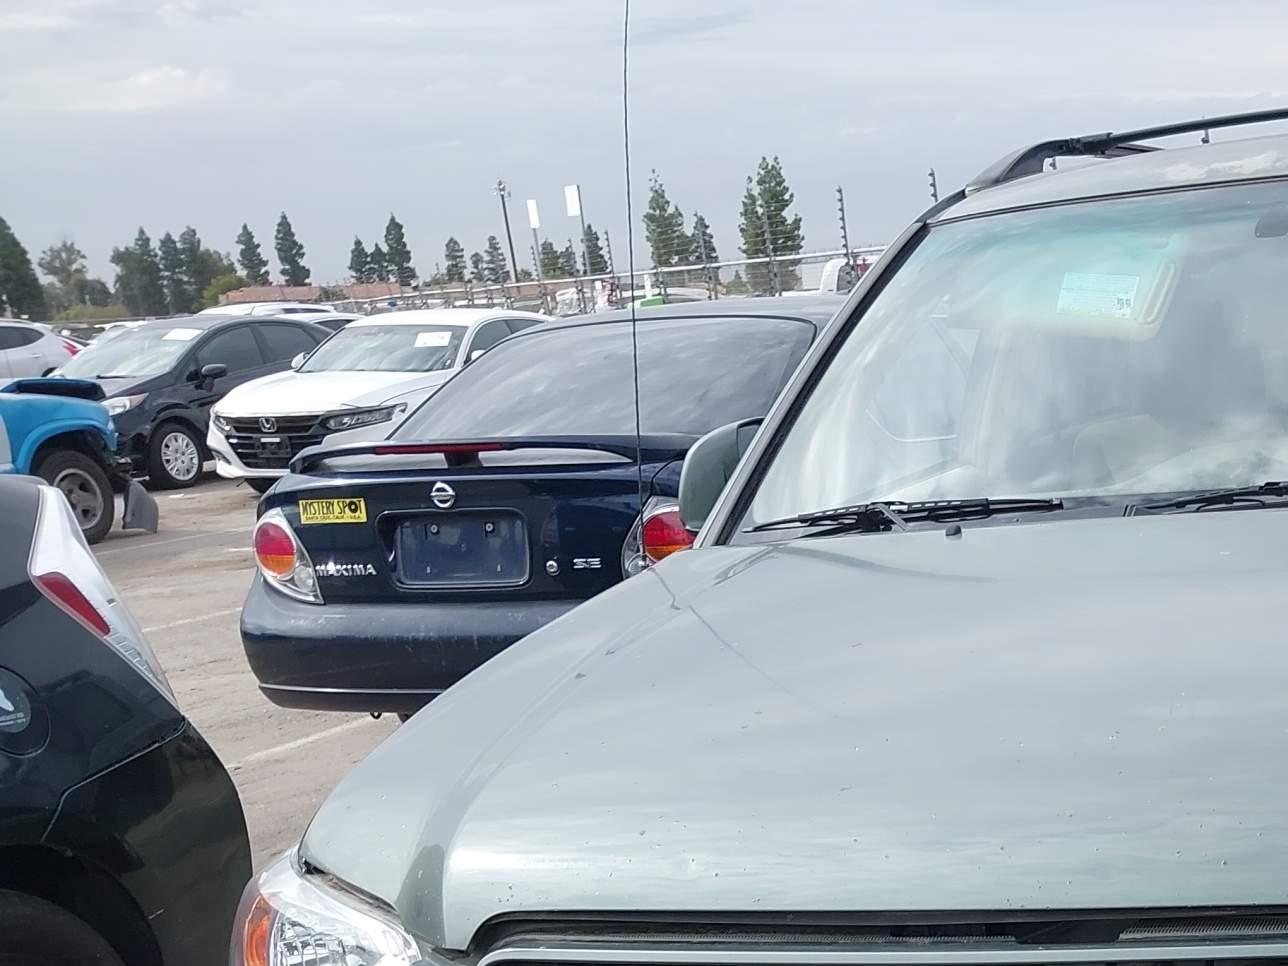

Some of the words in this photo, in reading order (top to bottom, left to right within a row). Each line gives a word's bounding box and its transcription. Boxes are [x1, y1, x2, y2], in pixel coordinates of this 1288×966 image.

[301, 501, 335, 516] MYSTERY
[336, 499, 363, 514] SPOT
[315, 561, 377, 577] MAXIMA
[573, 557, 602, 569] SE
